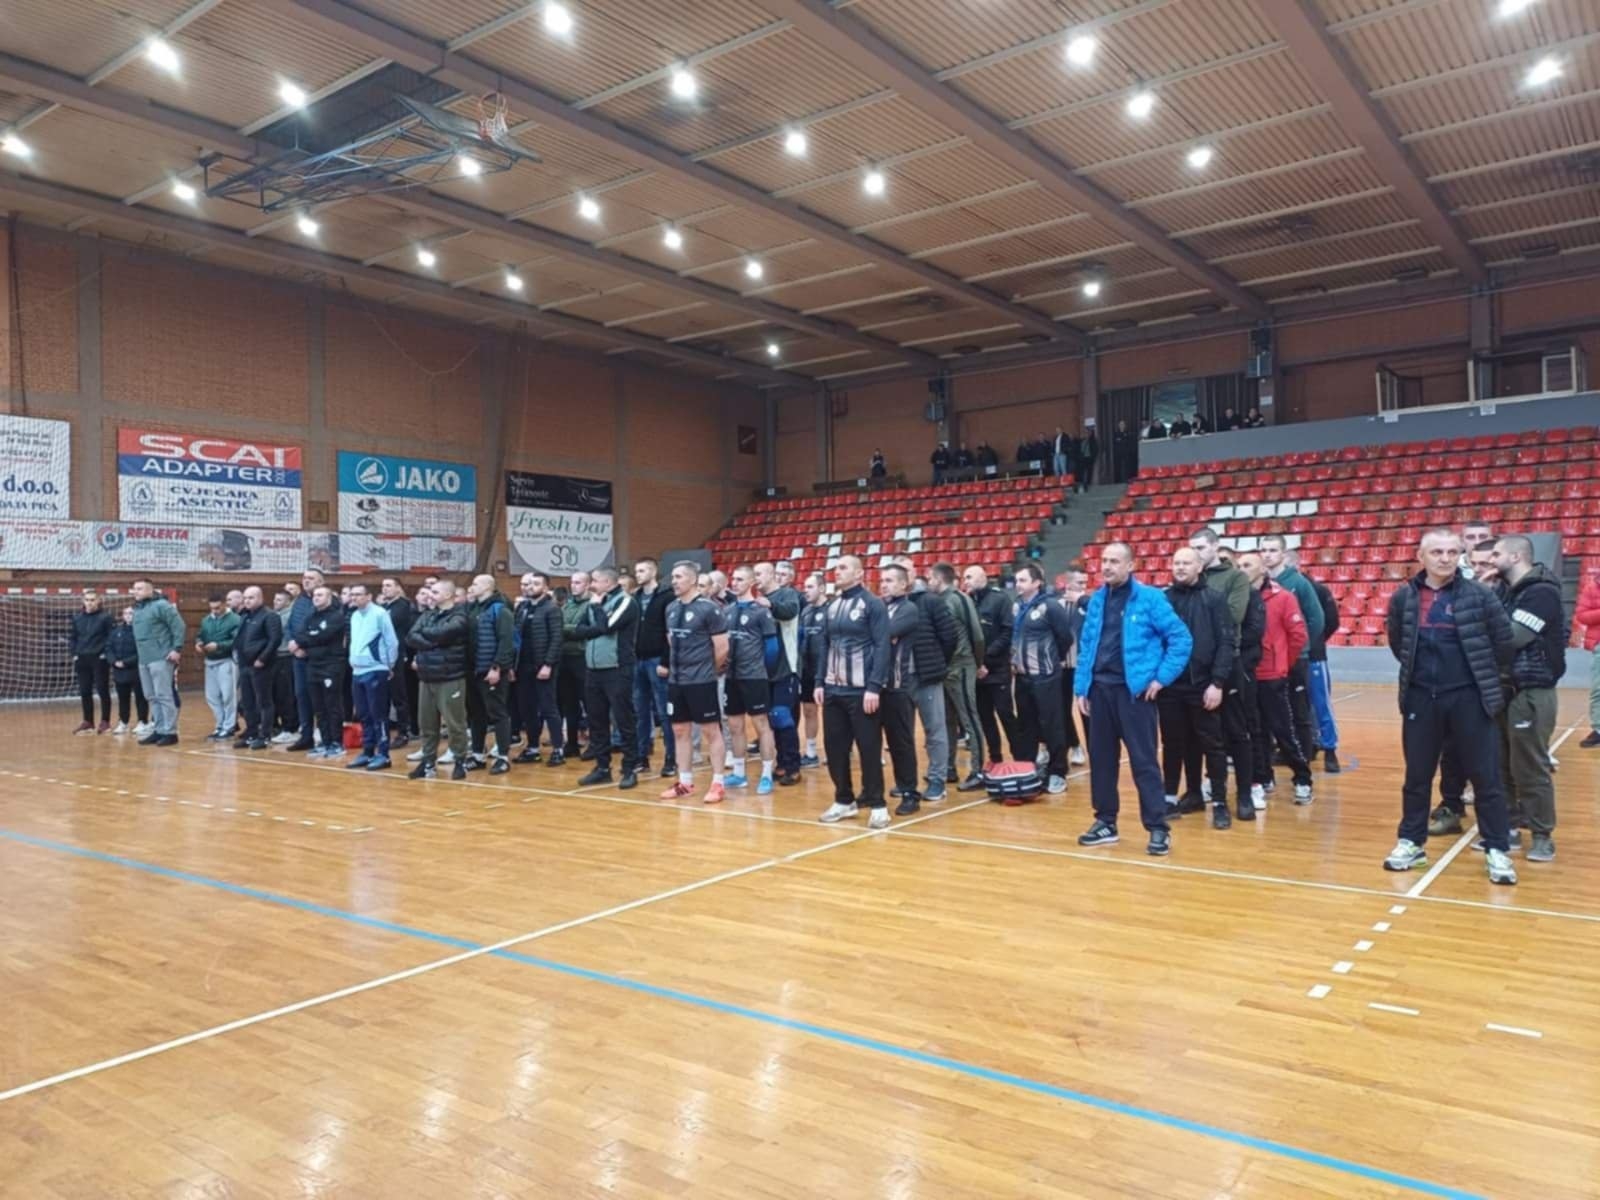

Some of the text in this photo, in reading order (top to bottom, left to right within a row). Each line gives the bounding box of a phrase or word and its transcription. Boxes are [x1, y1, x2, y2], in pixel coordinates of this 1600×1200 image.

[139, 434, 285, 468] SCAI
[142, 458, 273, 482] ADAPTER
[394, 466, 461, 494] JAKO
[3, 474, 59, 495] d.o.o.
[127, 527, 189, 540] REFLEKTA
[510, 511, 610, 534] Fresh bar
